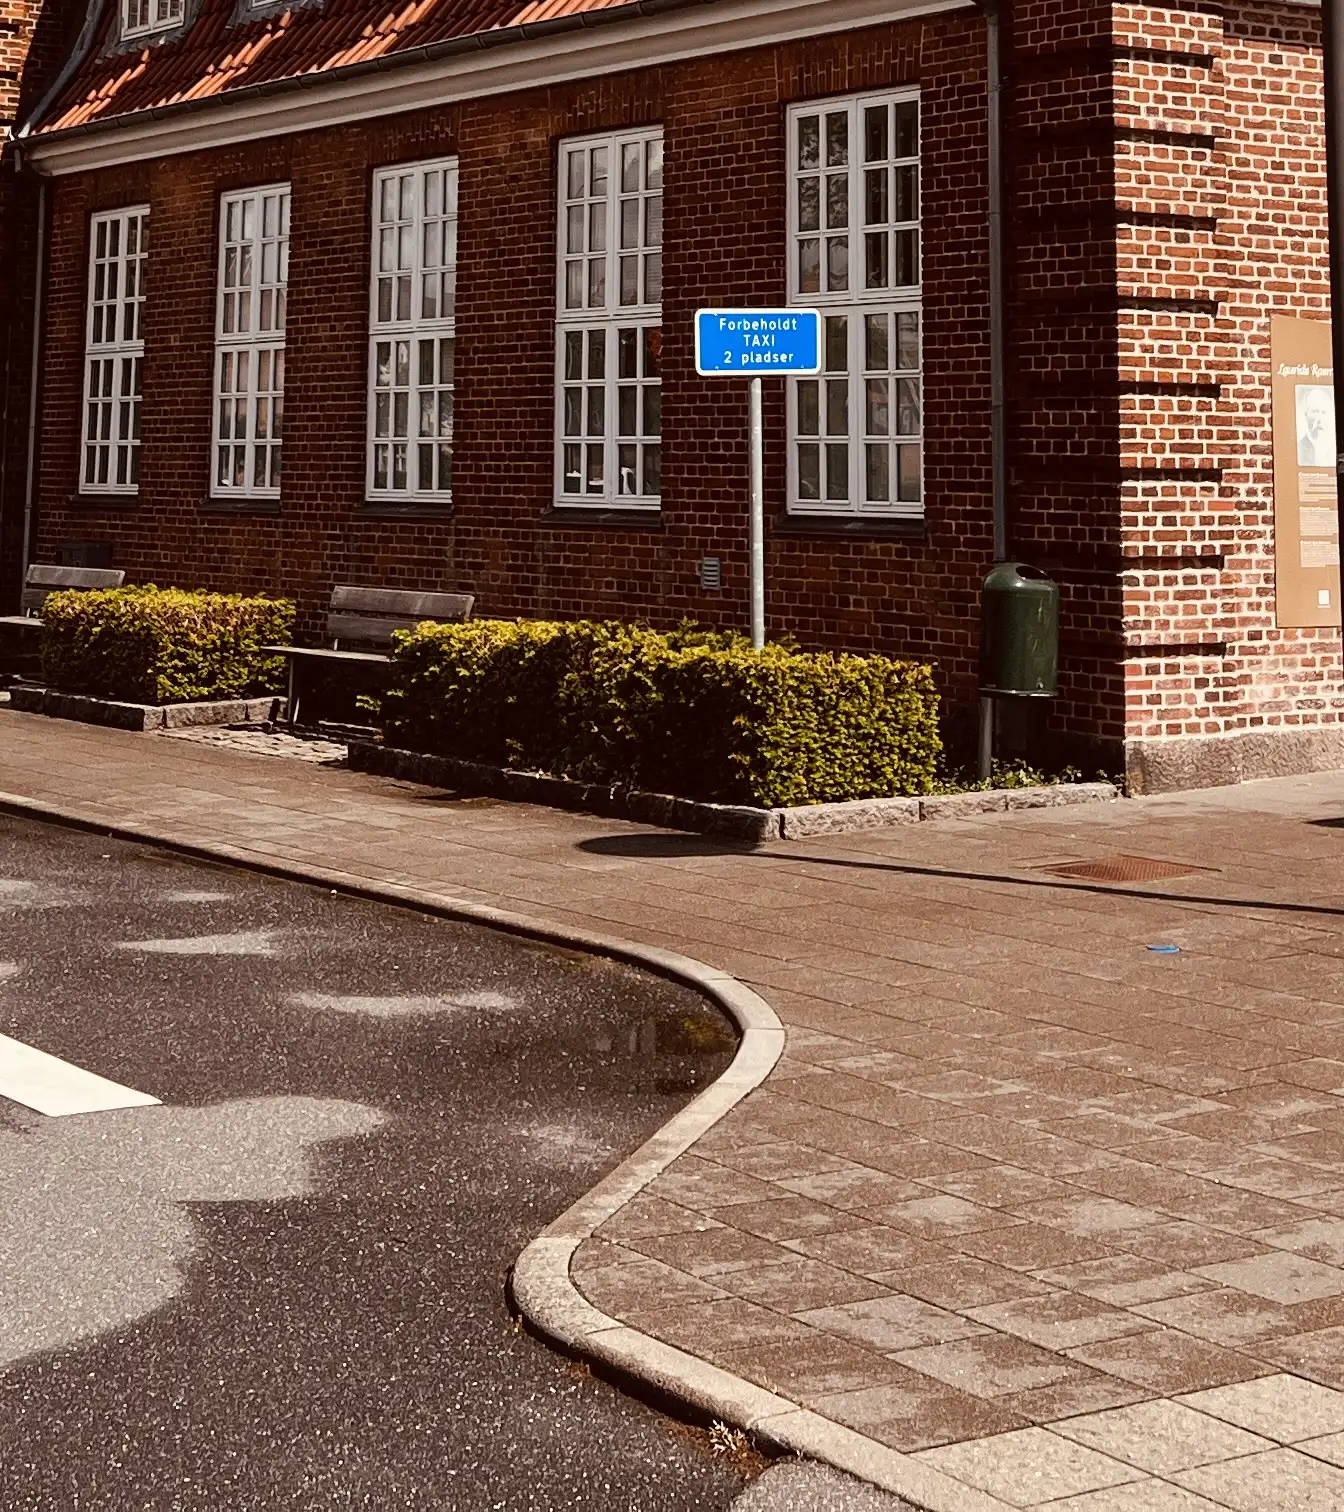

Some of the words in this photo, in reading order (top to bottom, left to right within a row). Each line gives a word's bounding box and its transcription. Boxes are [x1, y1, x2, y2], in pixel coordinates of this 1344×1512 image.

[719, 317, 797, 331] Forbeholdt
[743, 334, 775, 347] TAXI
[723, 350, 732, 364] 2
[741, 350, 794, 366] pladser
